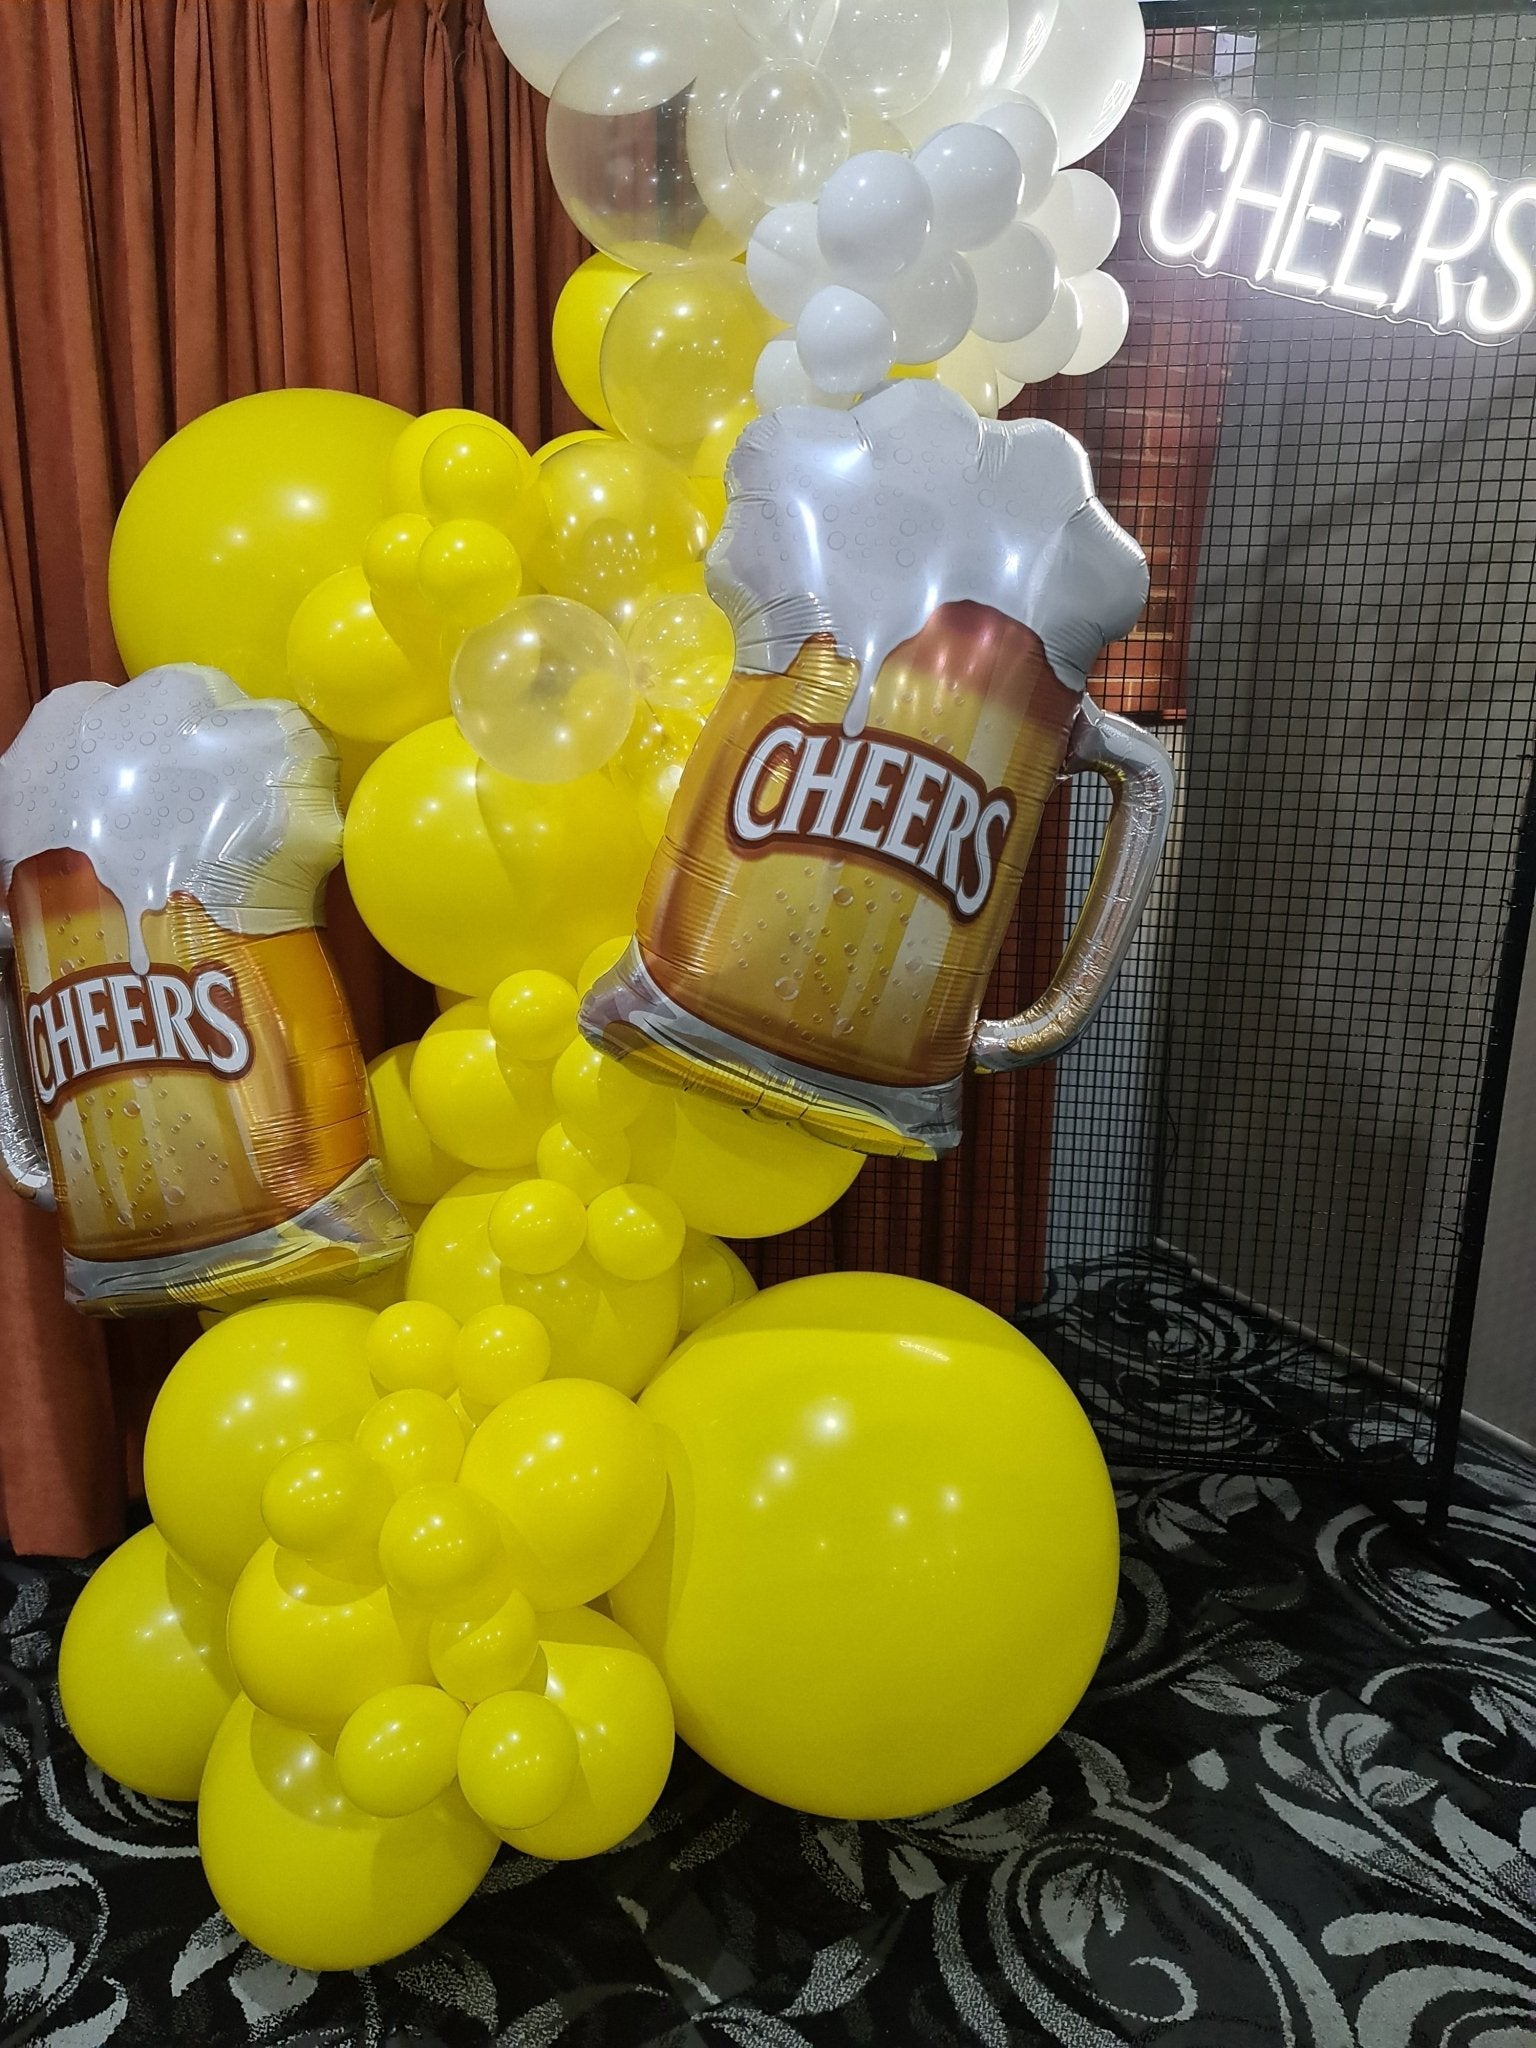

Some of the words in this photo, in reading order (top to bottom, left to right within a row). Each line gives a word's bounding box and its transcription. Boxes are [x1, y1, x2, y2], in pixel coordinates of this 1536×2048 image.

[1149, 103, 1536, 335] CHEERS
[732, 725, 1011, 916] CHEERS
[28, 970, 250, 1105] CHEERS
